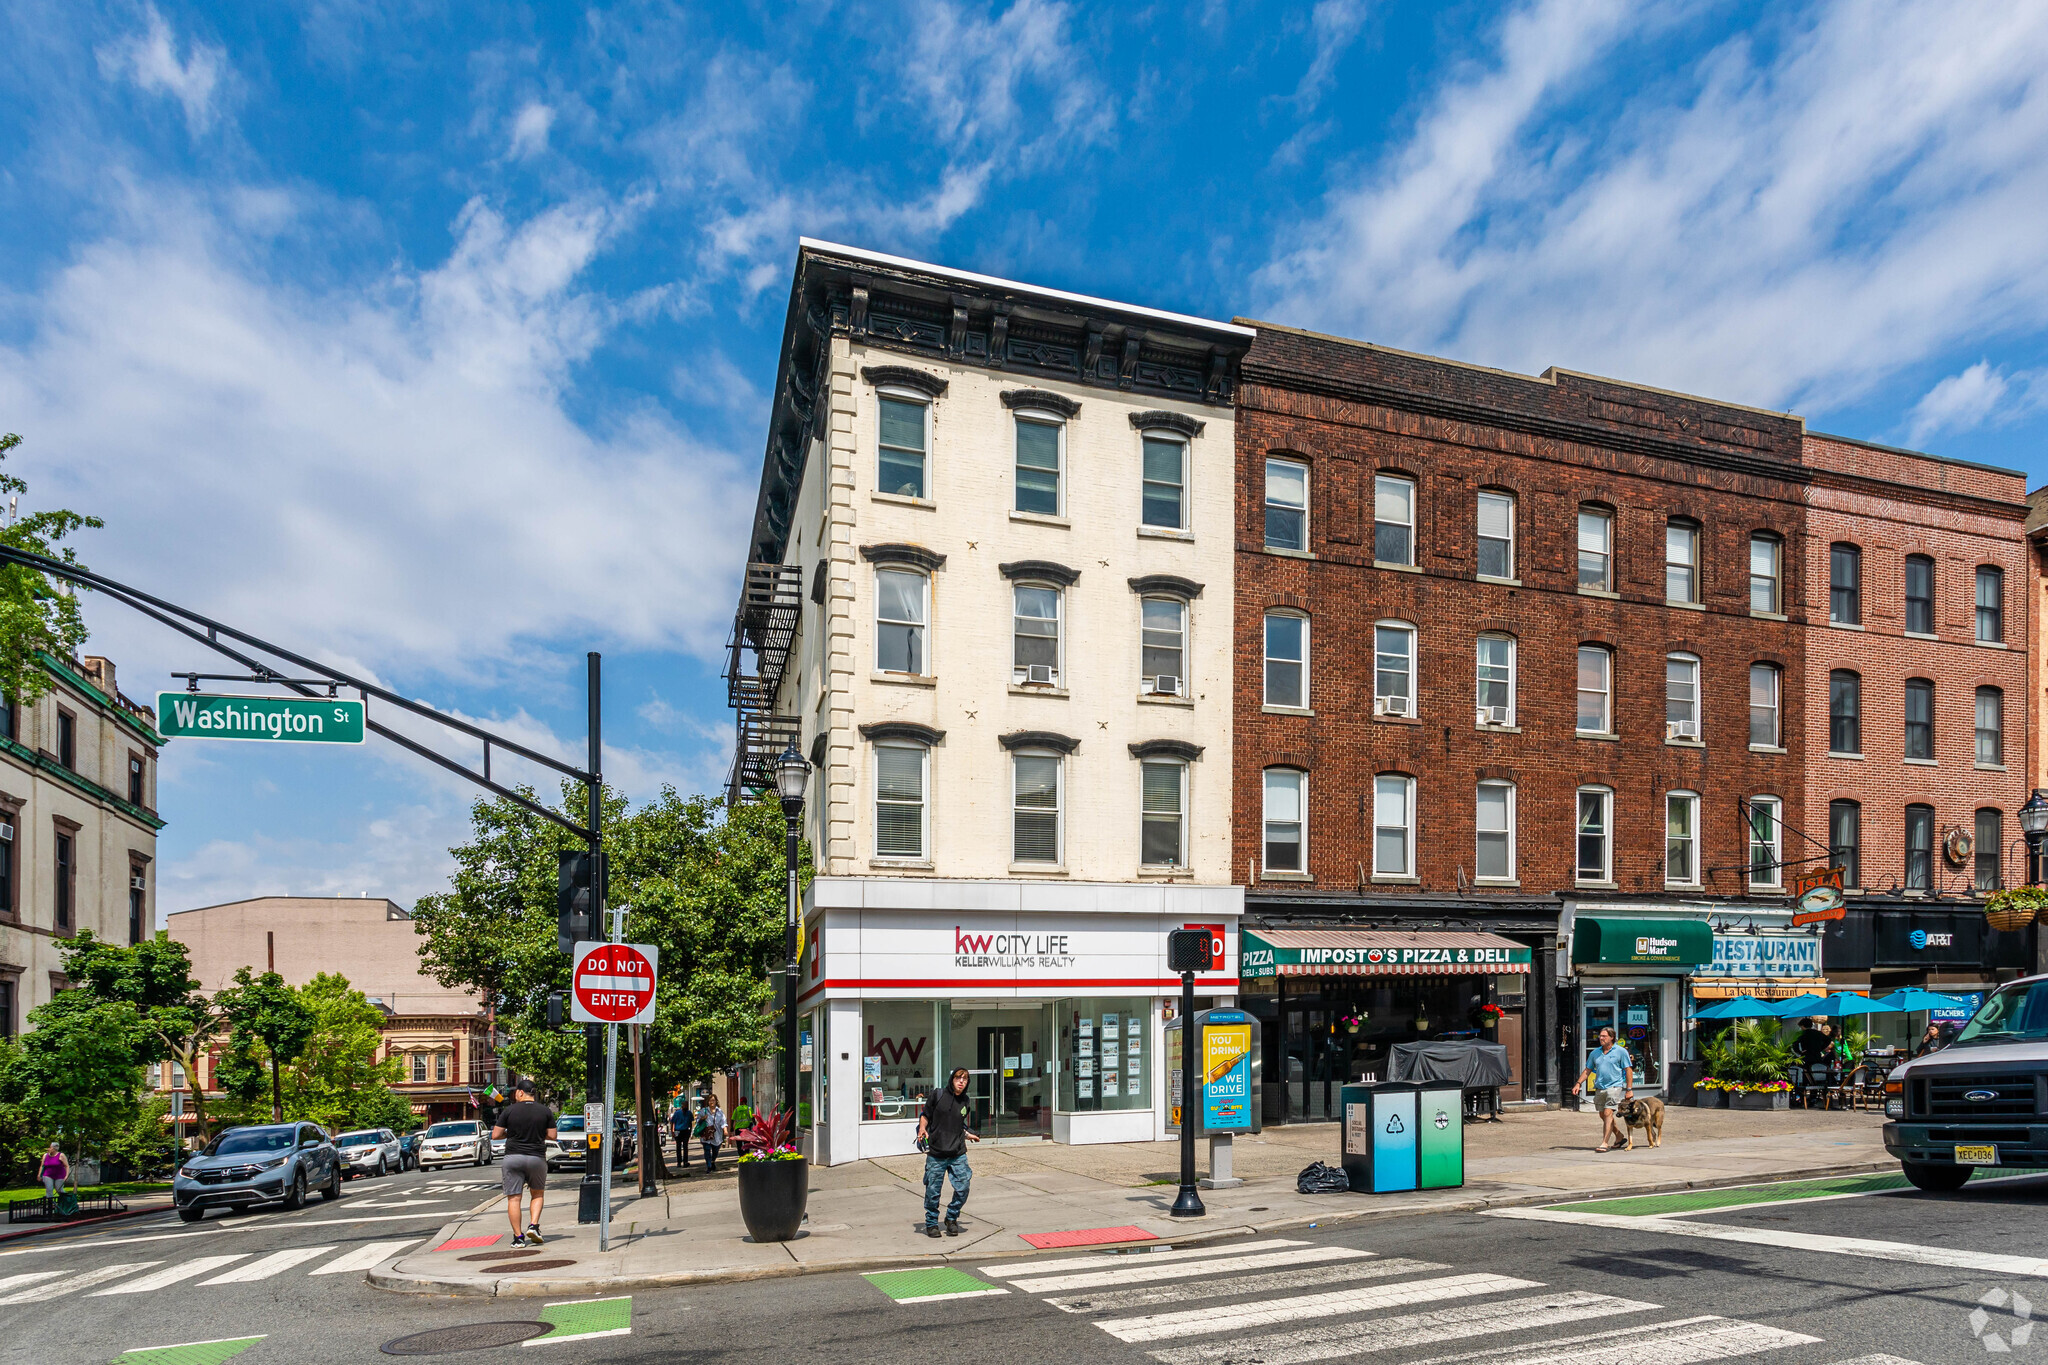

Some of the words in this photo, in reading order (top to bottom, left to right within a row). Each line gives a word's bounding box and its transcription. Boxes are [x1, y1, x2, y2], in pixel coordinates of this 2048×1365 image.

[174, 700, 323, 739] Washington
[333, 708, 349, 723] St
[1796, 873, 1843, 898] ISLA
[955, 925, 994, 954] kw
[996, 934, 1031, 954] CITY
[1036, 935, 1068, 954] LIFE
[1649, 937, 1677, 946] Hudson
[1926, 933, 1953, 946] AT&T
[1403, 949, 1452, 963] PIZZA
[1456, 949, 1469, 963] &
[1474, 949, 1510, 963] DELI
[1649, 946, 1667, 955] Mart
[1713, 940, 1817, 961] RESTAURANT
[1039, 956, 1075, 968] REALTY
[1242, 949, 1275, 967] PIZZA
[588, 958, 607, 971] DO
[617, 960, 645, 973] NOT
[1242, 968, 1255, 977] DELI
[1258, 967, 1274, 975] SUBS
[1725, 986, 1735, 997] La
[1737, 986, 1752, 997] Isla
[1754, 986, 1798, 997] Restaurant
[591, 993, 637, 1007] ENTER
[1934, 1009, 1965, 1017] TEACHERS
[1211, 1036, 1232, 1045] YOU
[1211, 1046, 1242, 1055] DRINK
[1225, 1074, 1242, 1083] WE
[1211, 1084, 1242, 1094] DRIVE
